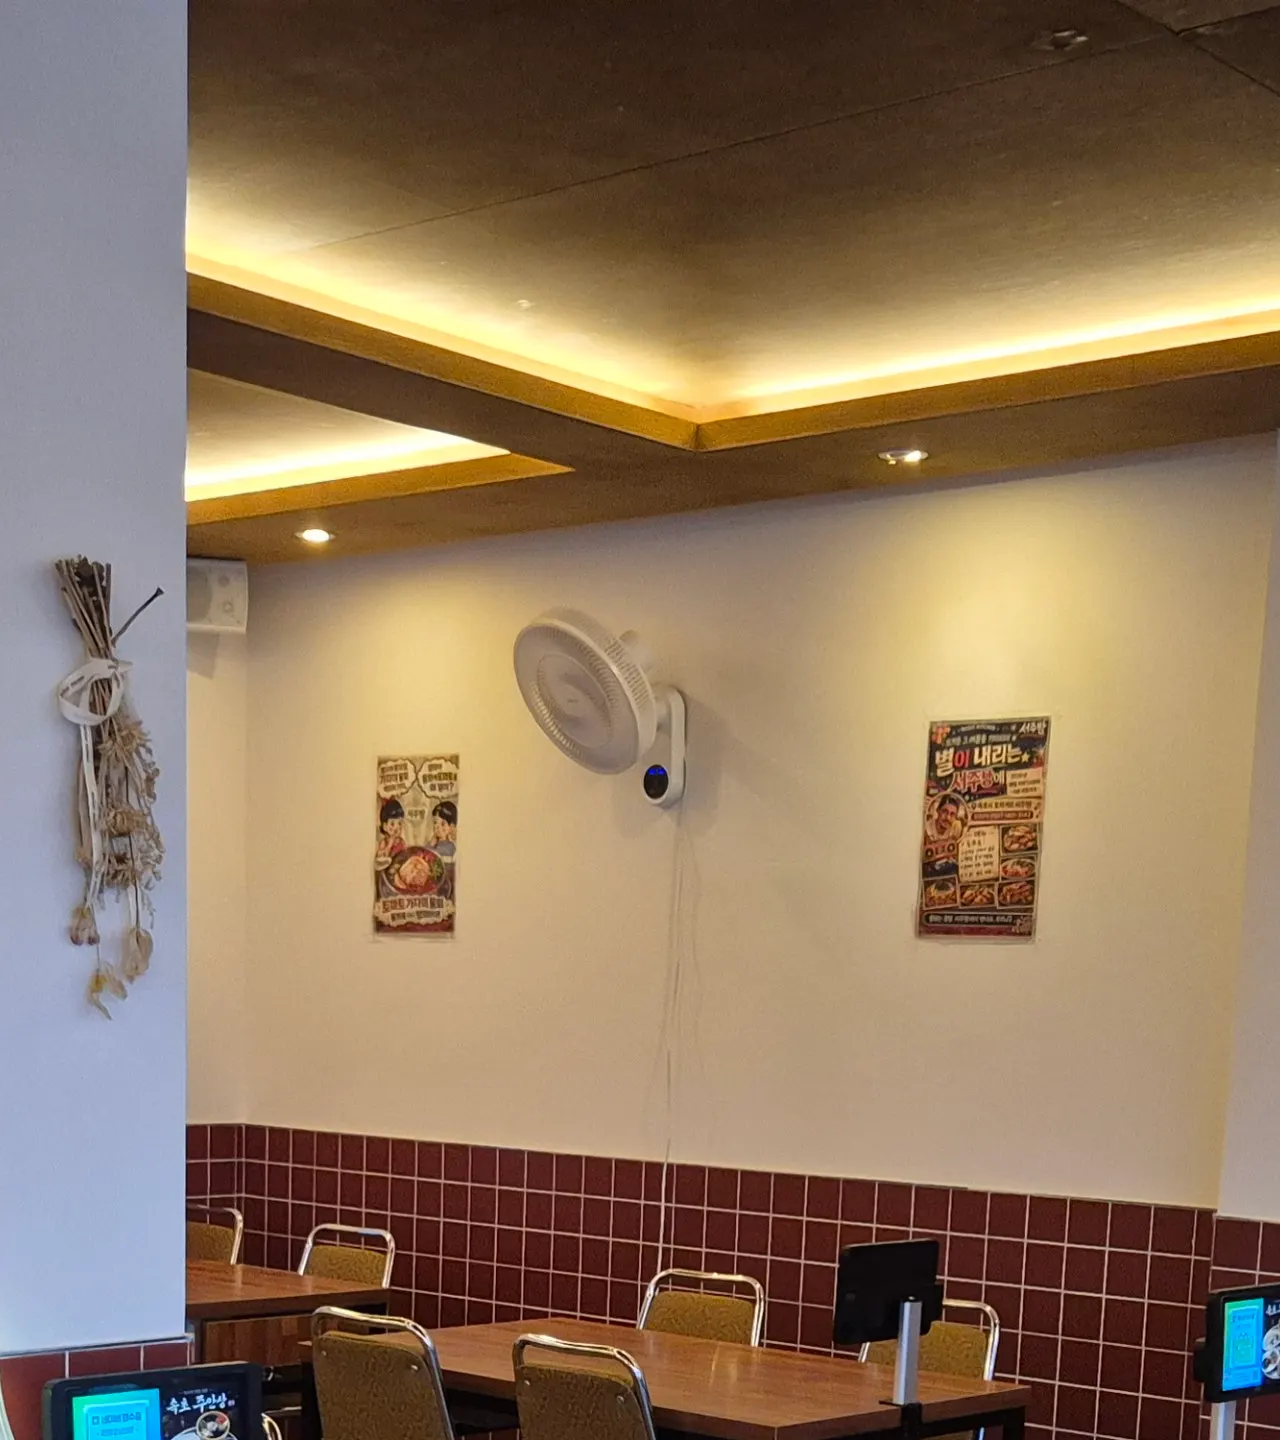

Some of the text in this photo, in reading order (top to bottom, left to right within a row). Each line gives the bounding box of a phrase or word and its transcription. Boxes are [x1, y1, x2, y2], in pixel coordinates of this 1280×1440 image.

[935, 743, 1022, 778] 별이 내리는
[166, 1392, 228, 1416] 속초 주안상
